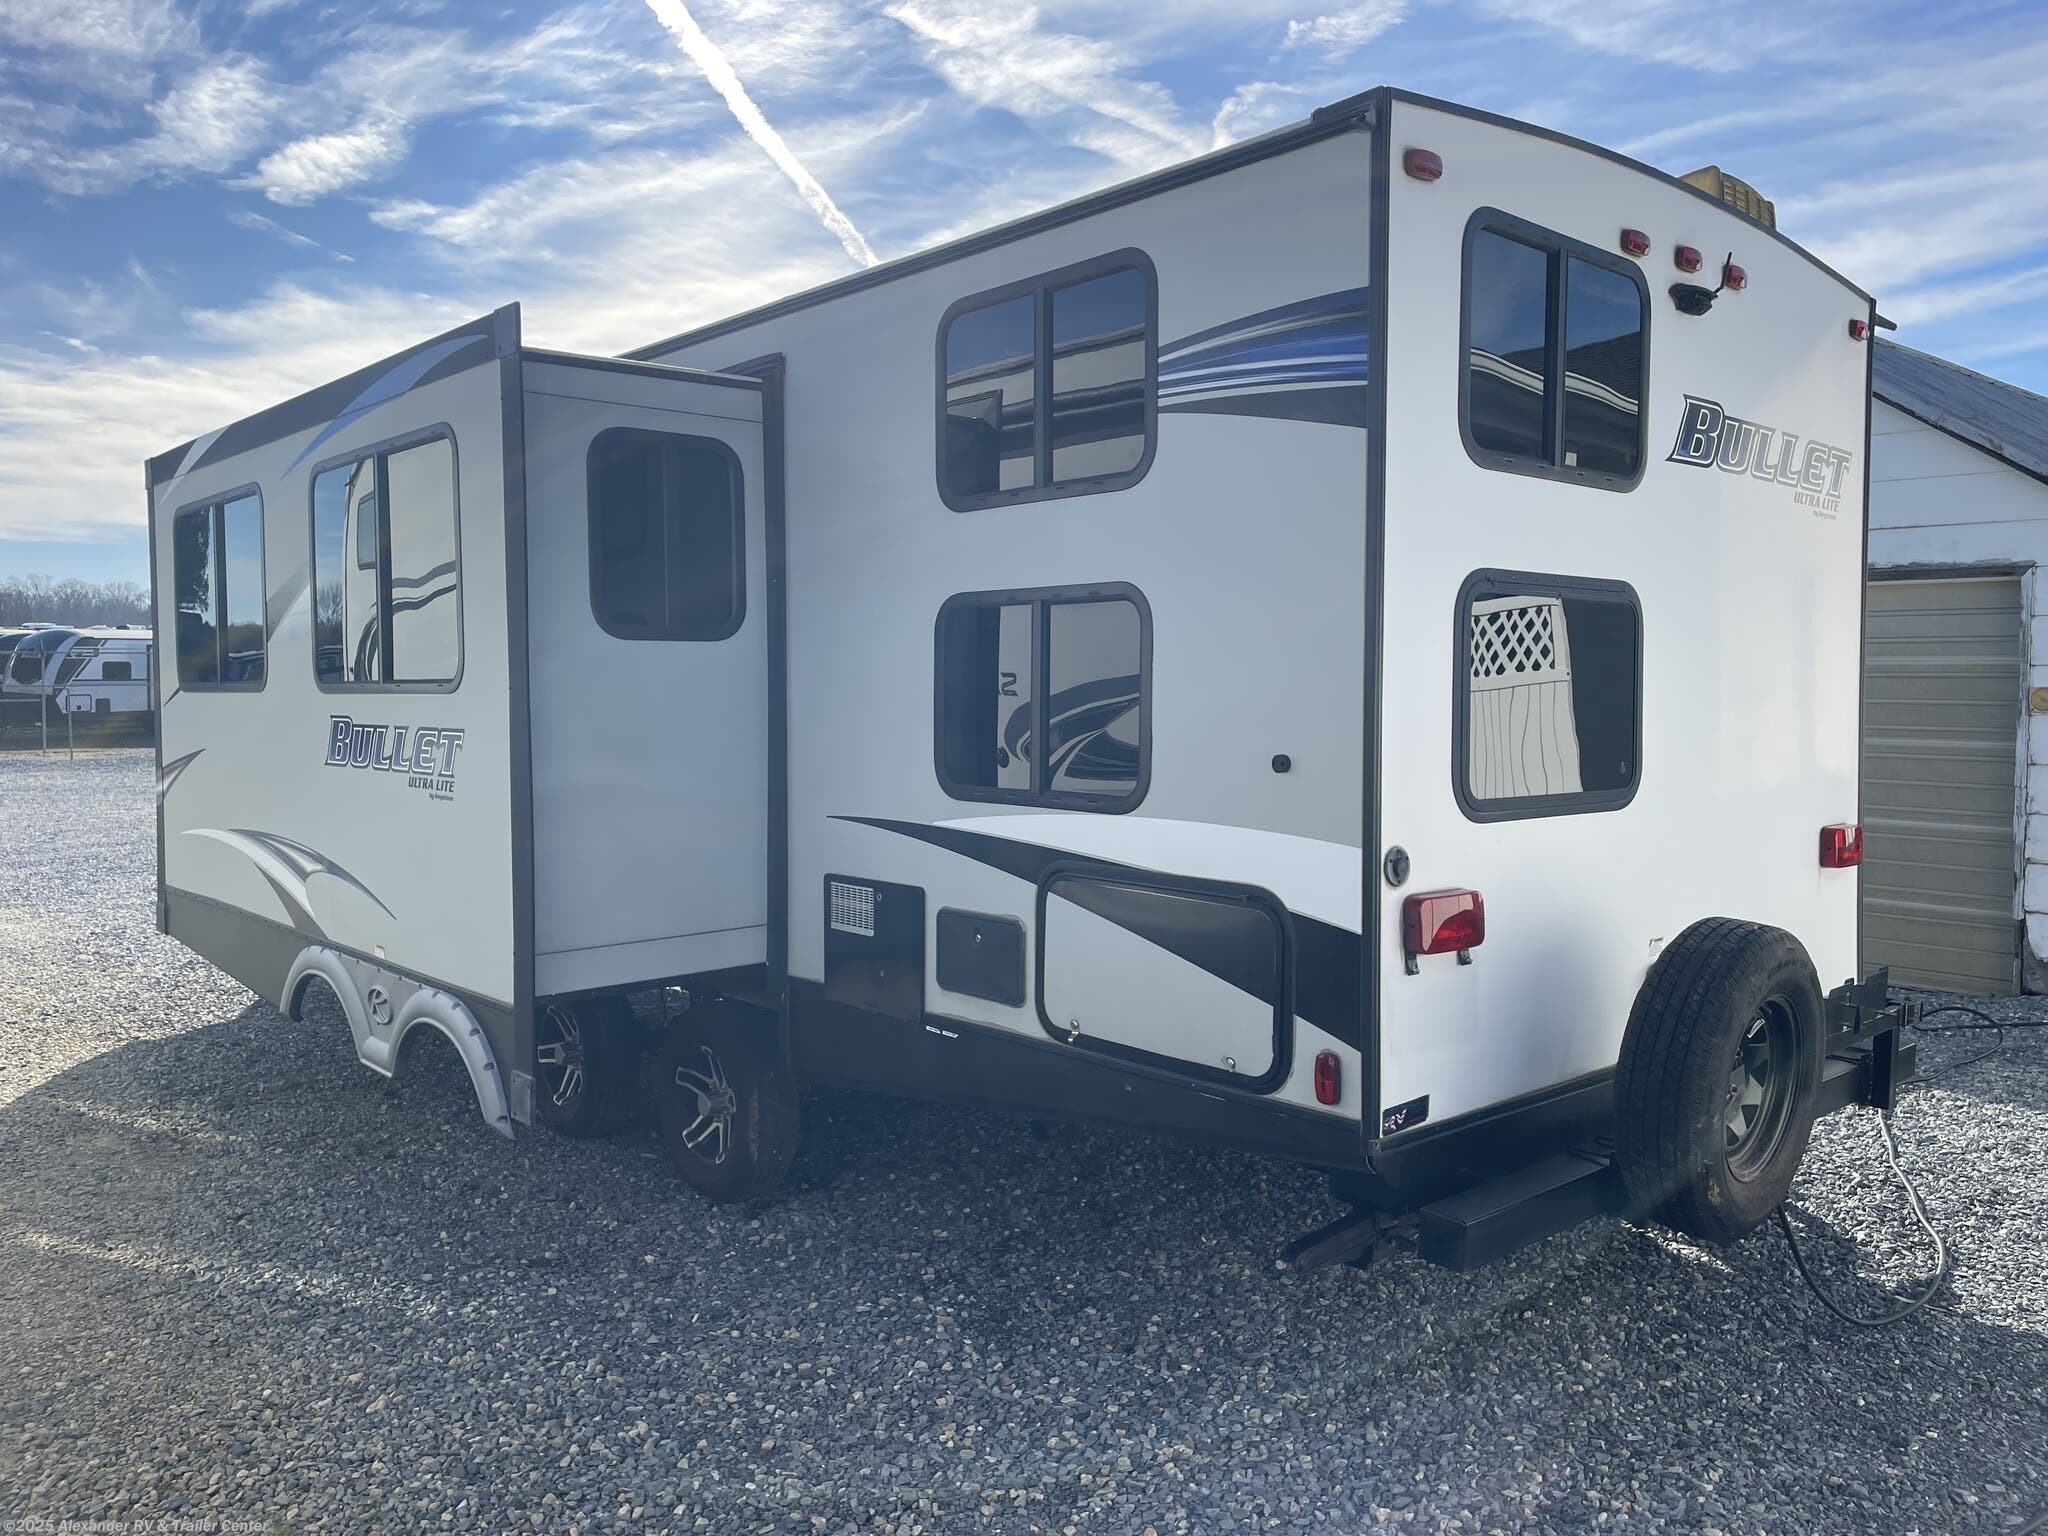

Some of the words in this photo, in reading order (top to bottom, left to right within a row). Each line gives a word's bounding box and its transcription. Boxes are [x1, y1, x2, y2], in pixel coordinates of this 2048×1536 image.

[1664, 393, 1852, 499] BULLET
[1793, 491, 1820, 508] ULTRA
[1822, 497, 1840, 512] LITE
[324, 714, 465, 778] BULLET
[408, 776, 433, 790] ULTRA
[436, 779, 455, 792] LITE
